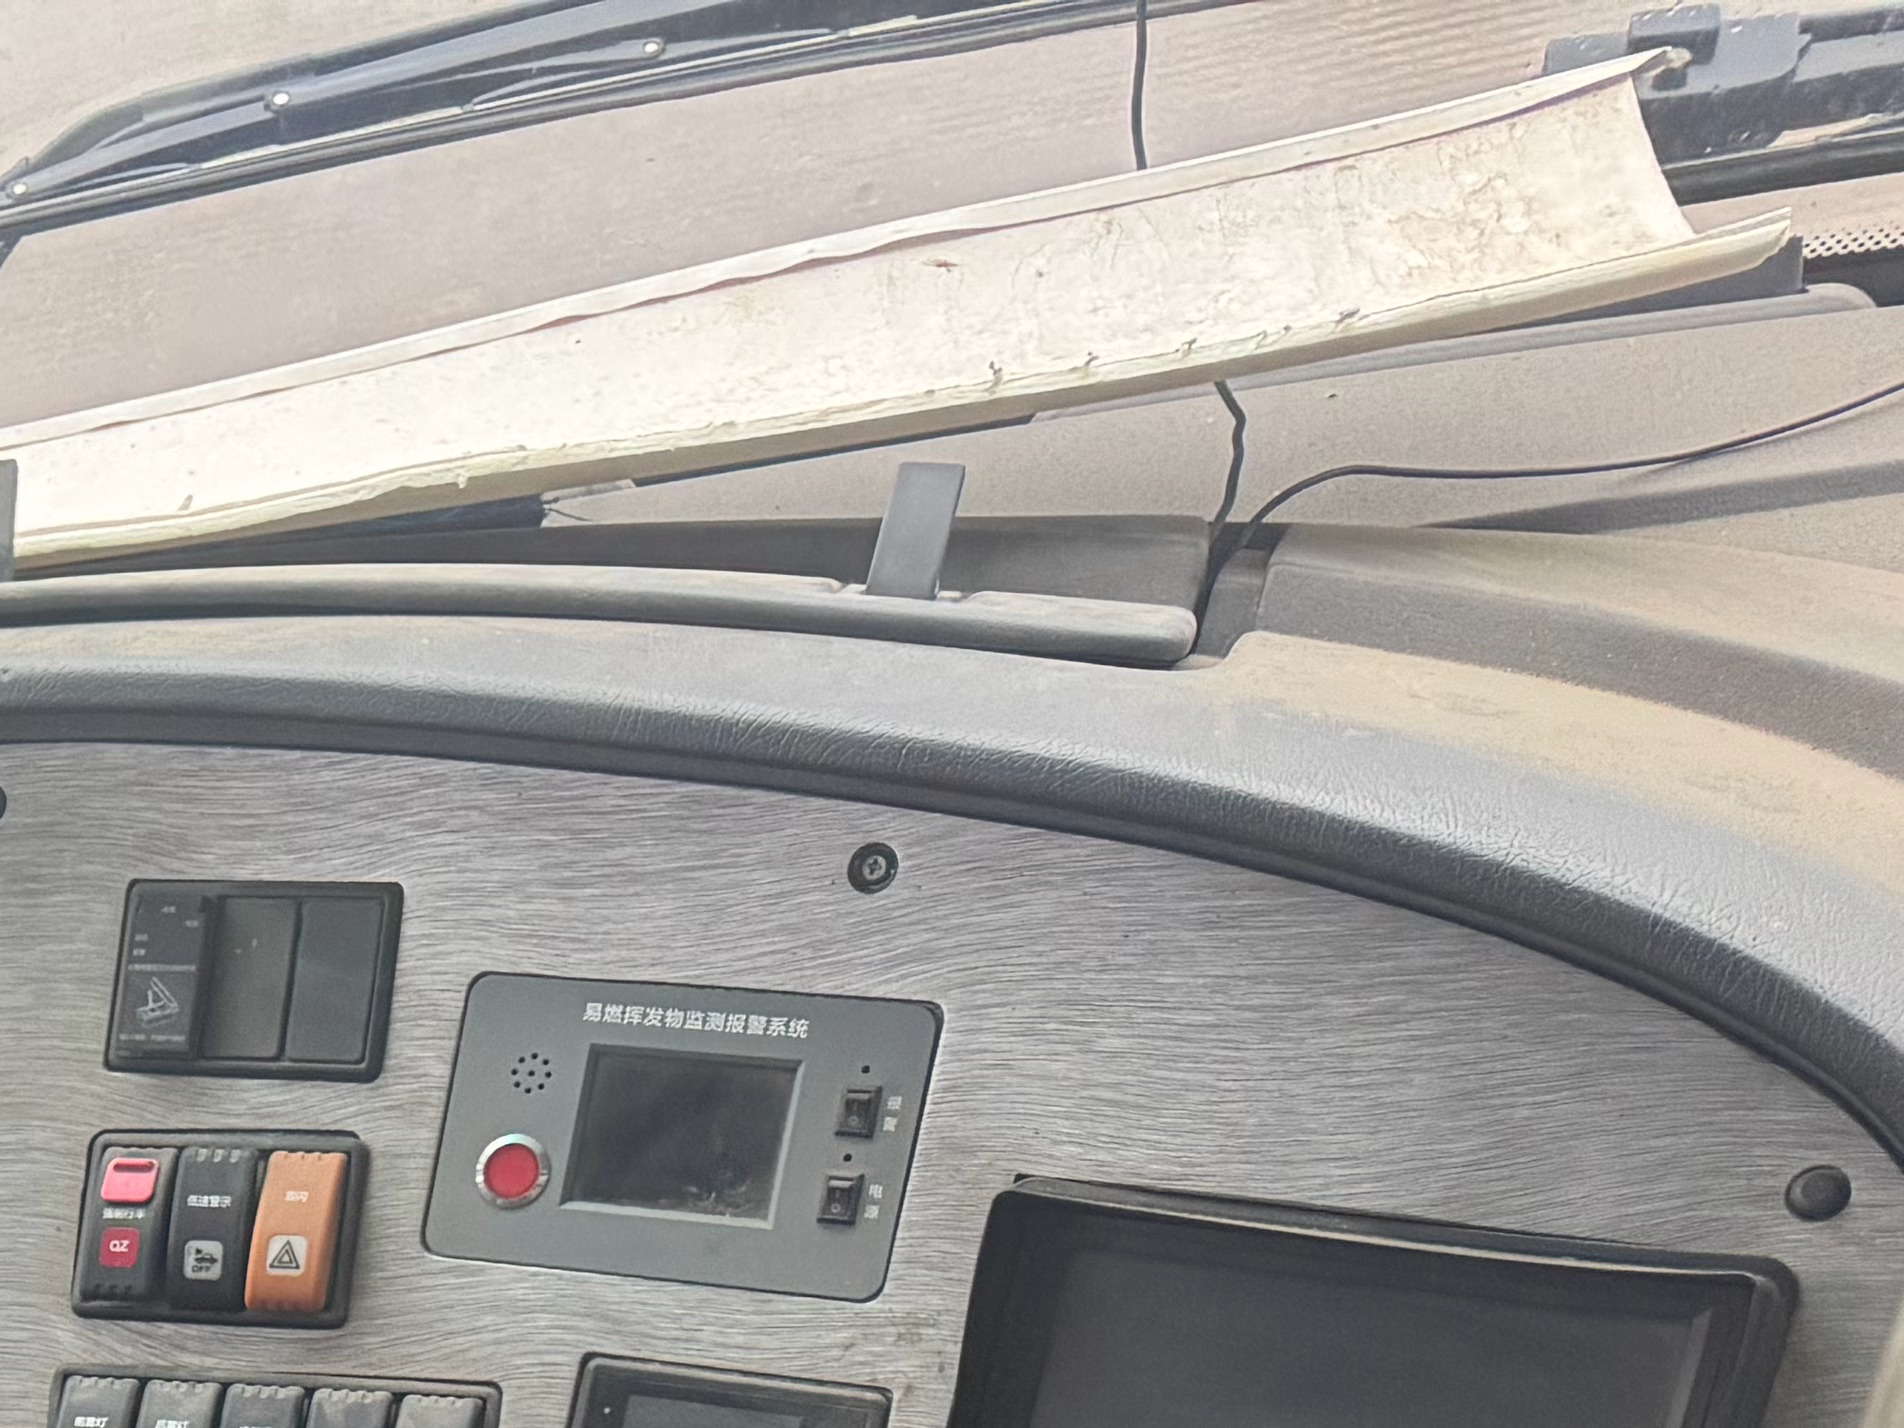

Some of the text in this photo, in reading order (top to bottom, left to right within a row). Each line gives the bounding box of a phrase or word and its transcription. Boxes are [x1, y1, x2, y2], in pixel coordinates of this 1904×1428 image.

[582, 1002, 810, 1040] 易燃挥发物监测报警系统
[109, 1239, 129, 1251] QZ
